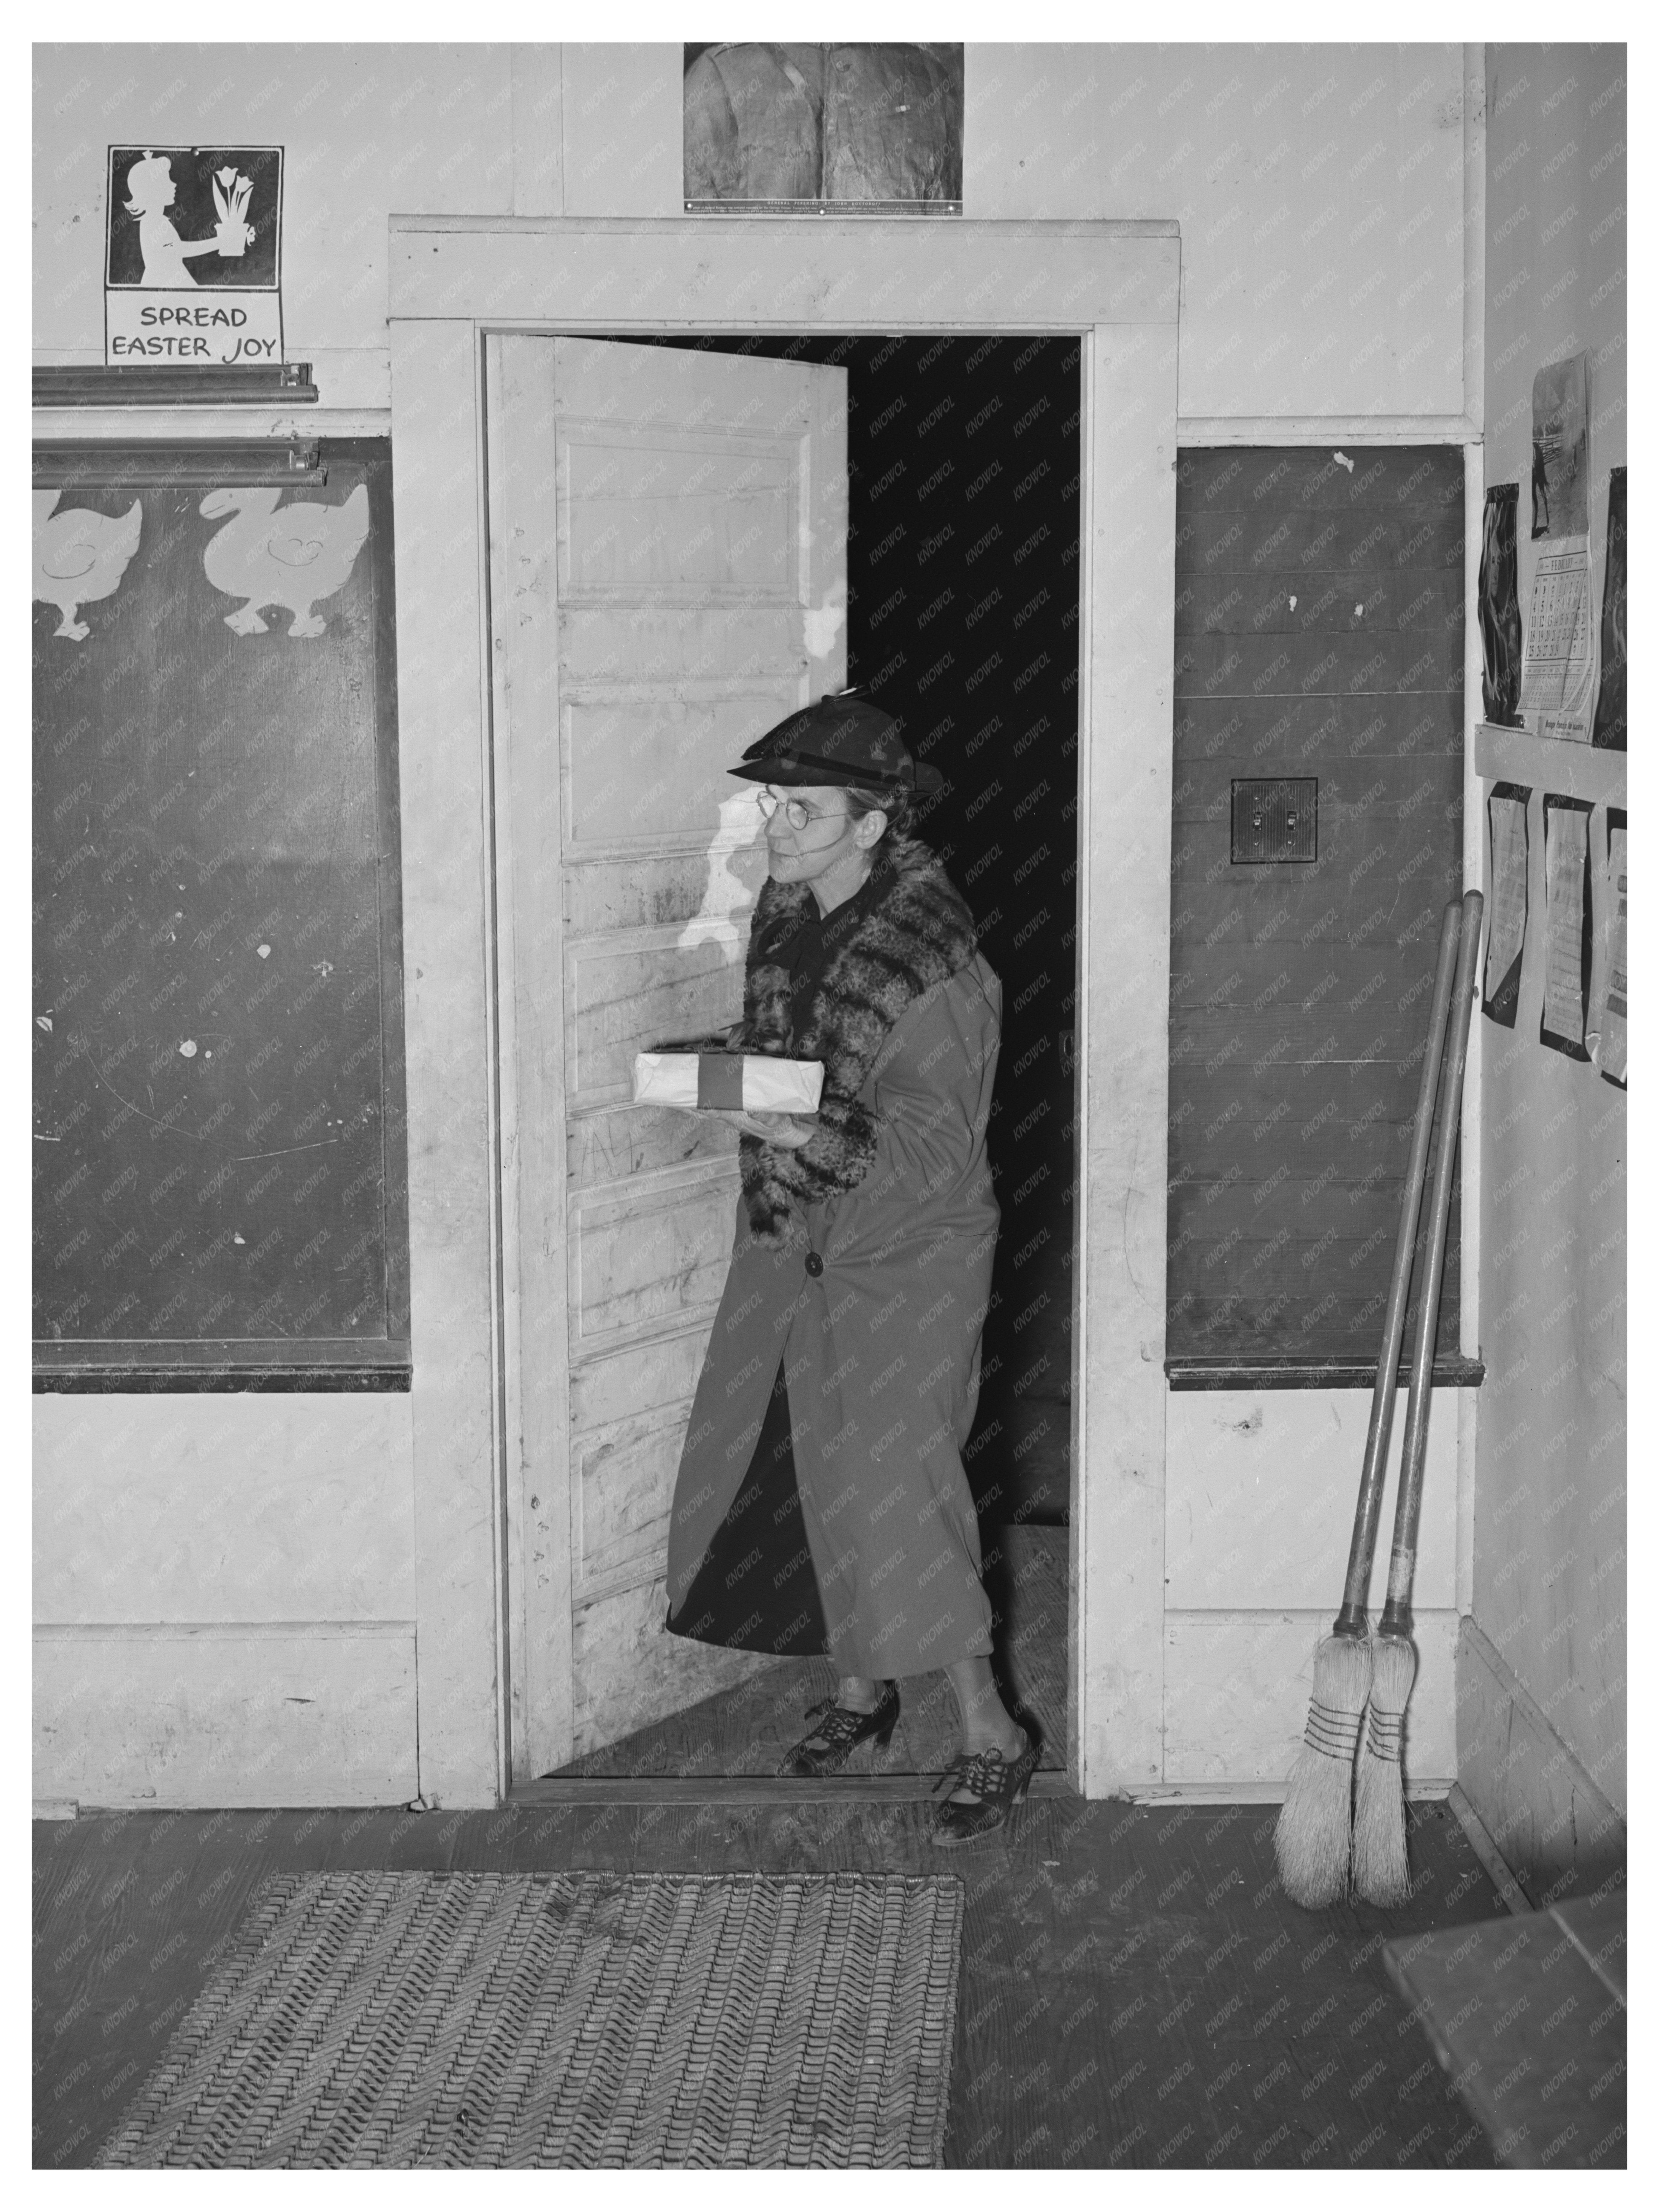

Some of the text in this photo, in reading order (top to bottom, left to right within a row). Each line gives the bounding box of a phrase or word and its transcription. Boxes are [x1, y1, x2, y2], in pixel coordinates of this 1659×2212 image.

[140, 307, 246, 326] SPREAD
[113, 337, 276, 364] EASTER JOY
[1533, 602, 1536, 612] 4
[1541, 600, 1544, 612] 5
[1549, 600, 1553, 612] 6
[1531, 616, 1536, 627] 11
[1539, 615, 1544, 627] 12
[1548, 615, 1552, 627] 13
[1530, 630, 1536, 642] 18
[1538, 630, 1544, 642] 19
[1529, 645, 1534, 657] 25
